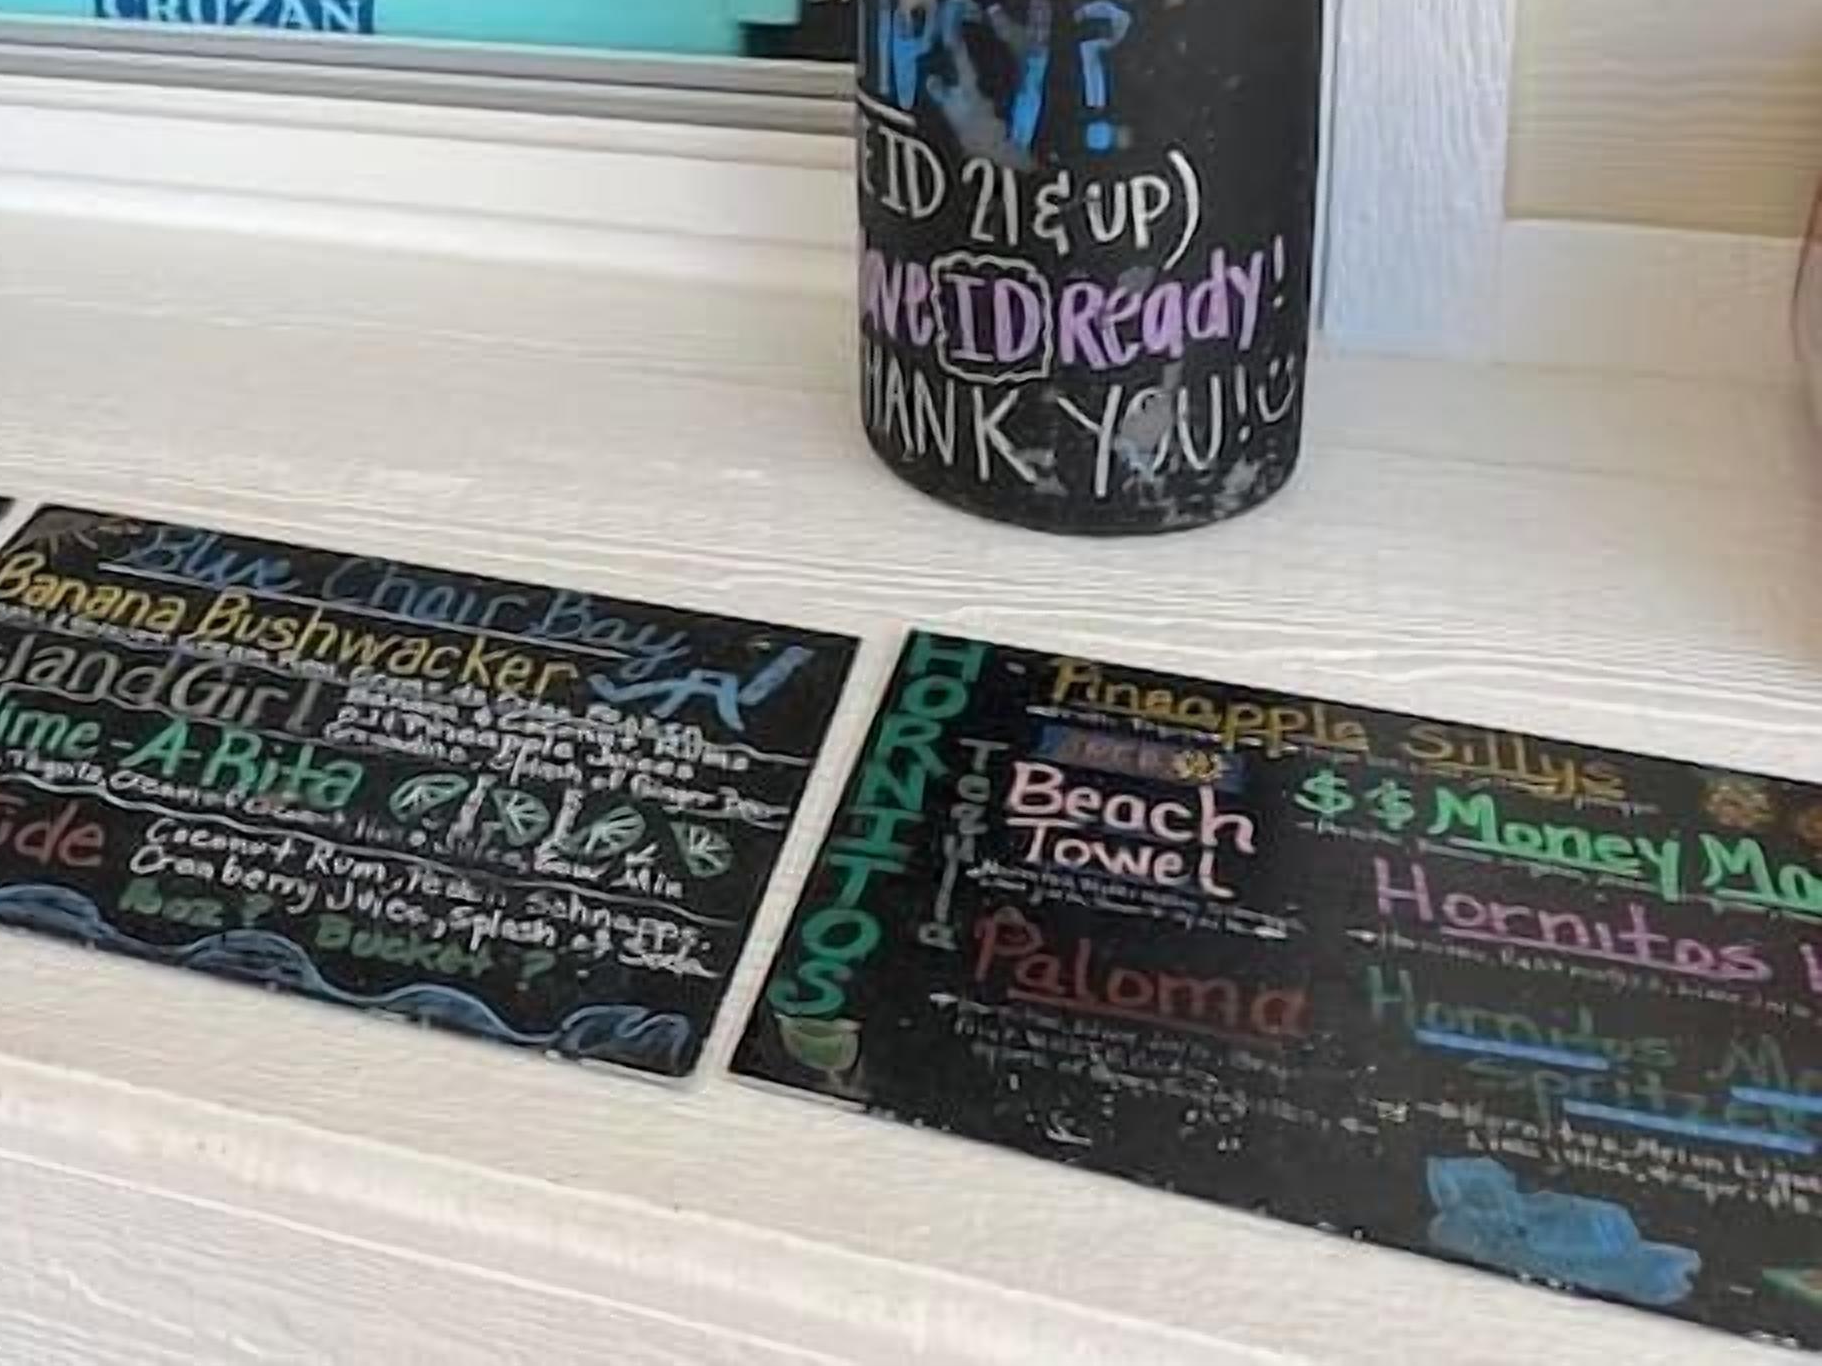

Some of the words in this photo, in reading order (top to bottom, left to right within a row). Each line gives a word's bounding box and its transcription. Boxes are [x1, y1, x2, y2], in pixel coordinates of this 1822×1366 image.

[942, 272, 1041, 365] ID
[1057, 236, 1288, 371] Ready!
[190, 586, 581, 698] Bushwacker
[322, 556, 530, 632] Chair
[768, 632, 994, 1018] HORNITOS
[1006, 817, 1236, 899] Towel
[1007, 760, 1256, 856] Beach
[974, 906, 1316, 1036] Paloma
[1373, 856, 1774, 982] Hornitos
